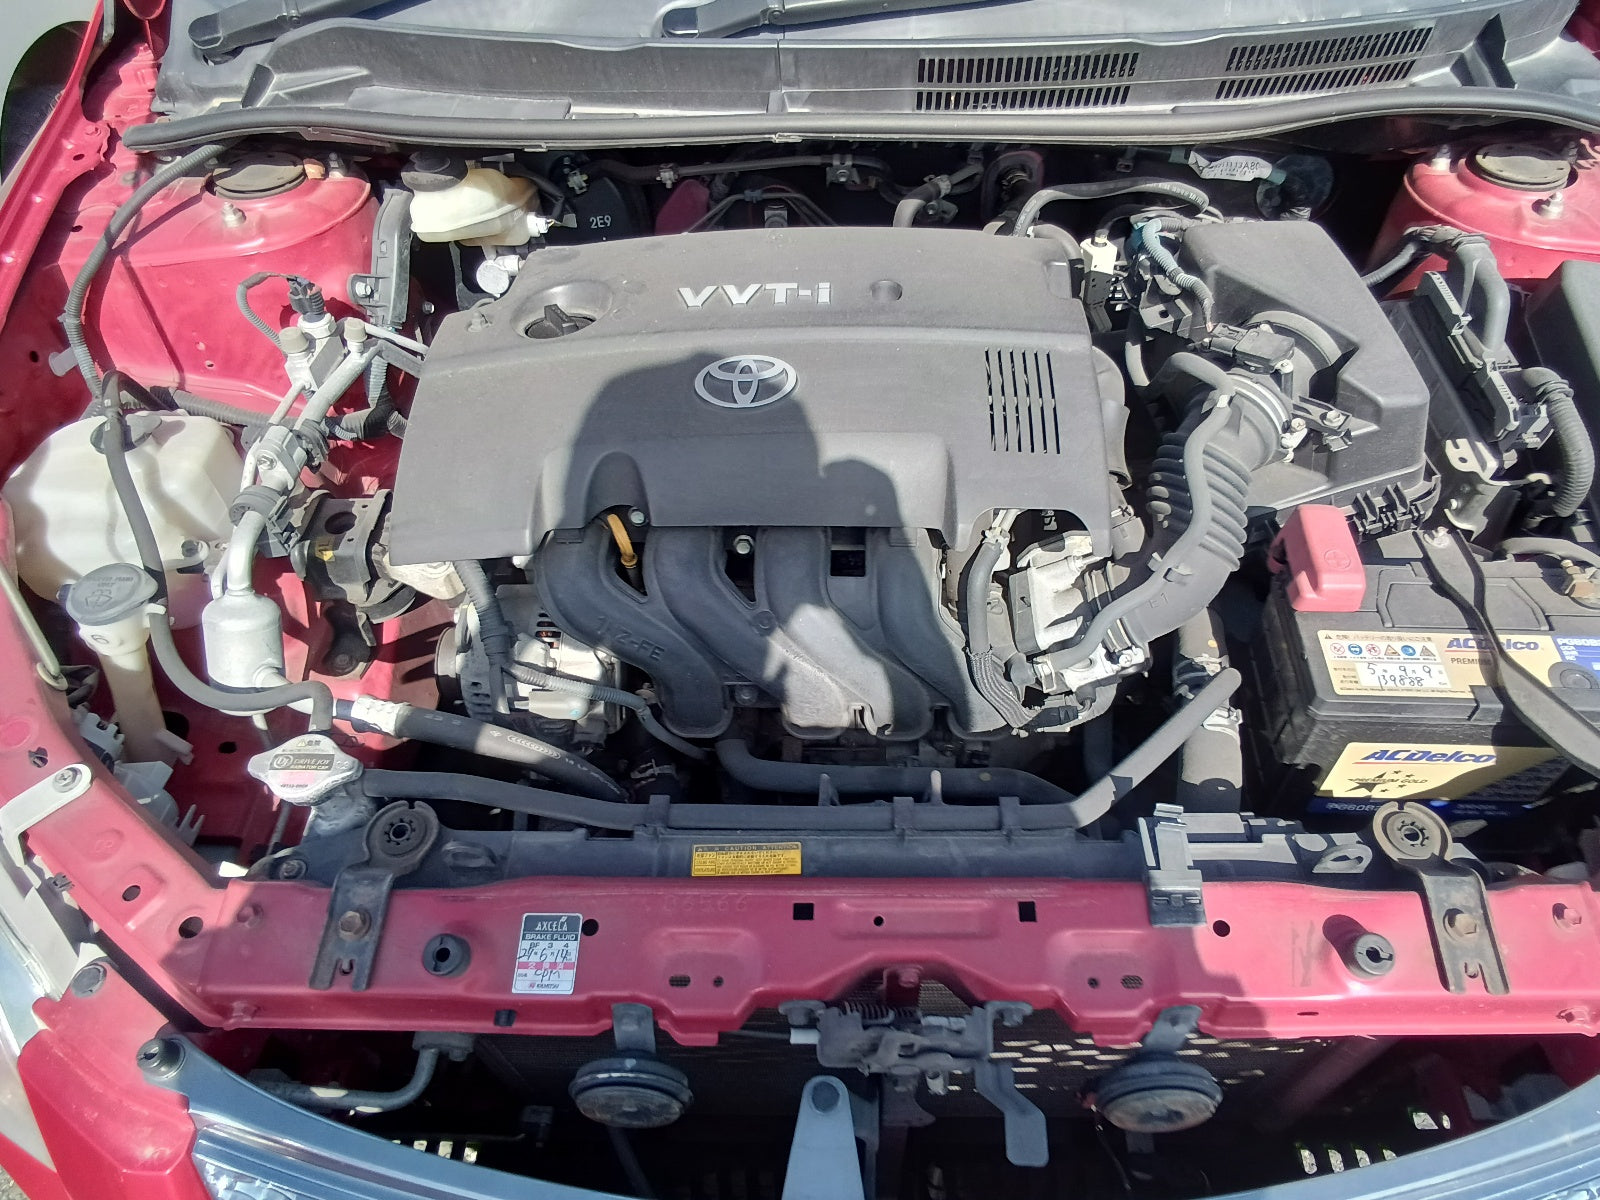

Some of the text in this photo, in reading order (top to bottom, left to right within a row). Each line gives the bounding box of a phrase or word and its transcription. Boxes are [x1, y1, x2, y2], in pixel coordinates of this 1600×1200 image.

[589, 215, 612, 229] 2E9
[678, 282, 832, 309] VVT-i
[1367, 662, 1378, 675] 5
[1399, 665, 1409, 677] 9
[1423, 665, 1433, 679] 9
[1361, 749, 1497, 763] ACDelco
[535, 921, 568, 931] AXCELA
